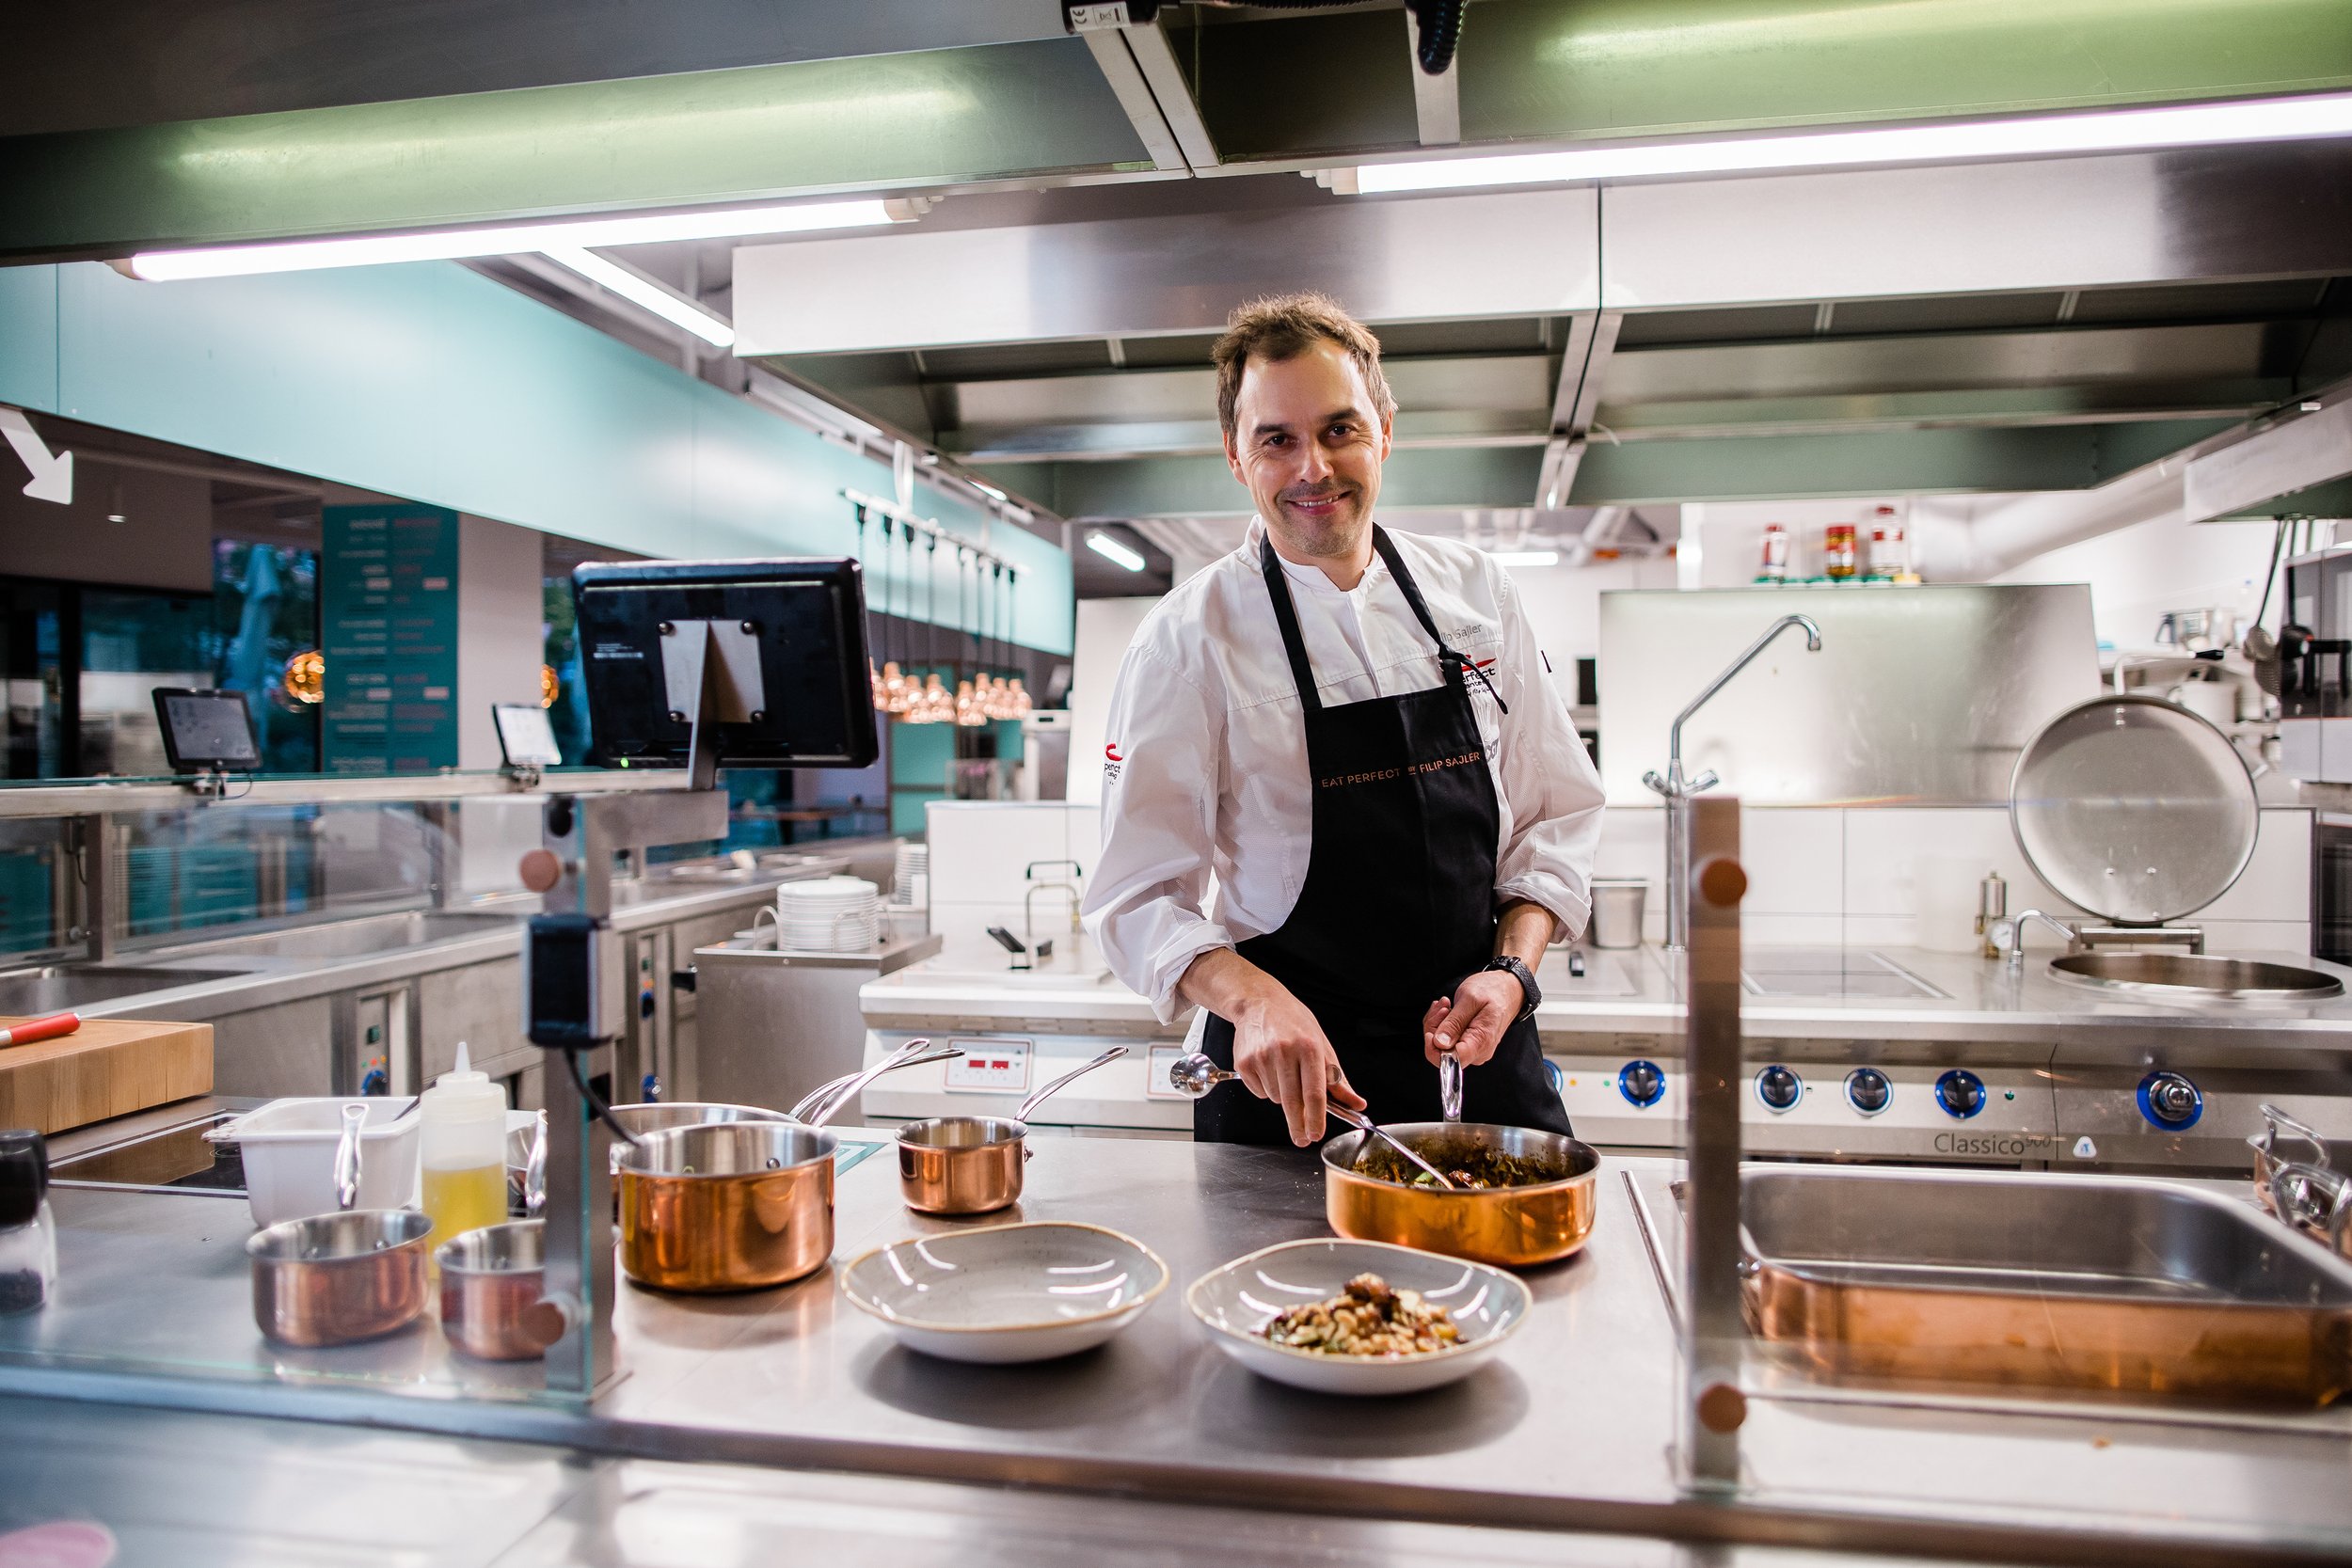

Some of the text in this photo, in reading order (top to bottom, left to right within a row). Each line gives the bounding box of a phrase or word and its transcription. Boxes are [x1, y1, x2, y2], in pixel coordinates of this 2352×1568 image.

[1454, 625, 1482, 639] Sajler
[1462, 667, 1496, 683] rfect
[1321, 776, 1344, 788] EAT
[1347, 768, 1401, 785] PERFECT
[1419, 761, 1443, 773] FILIP
[1445, 752, 1481, 768] SAJLER
